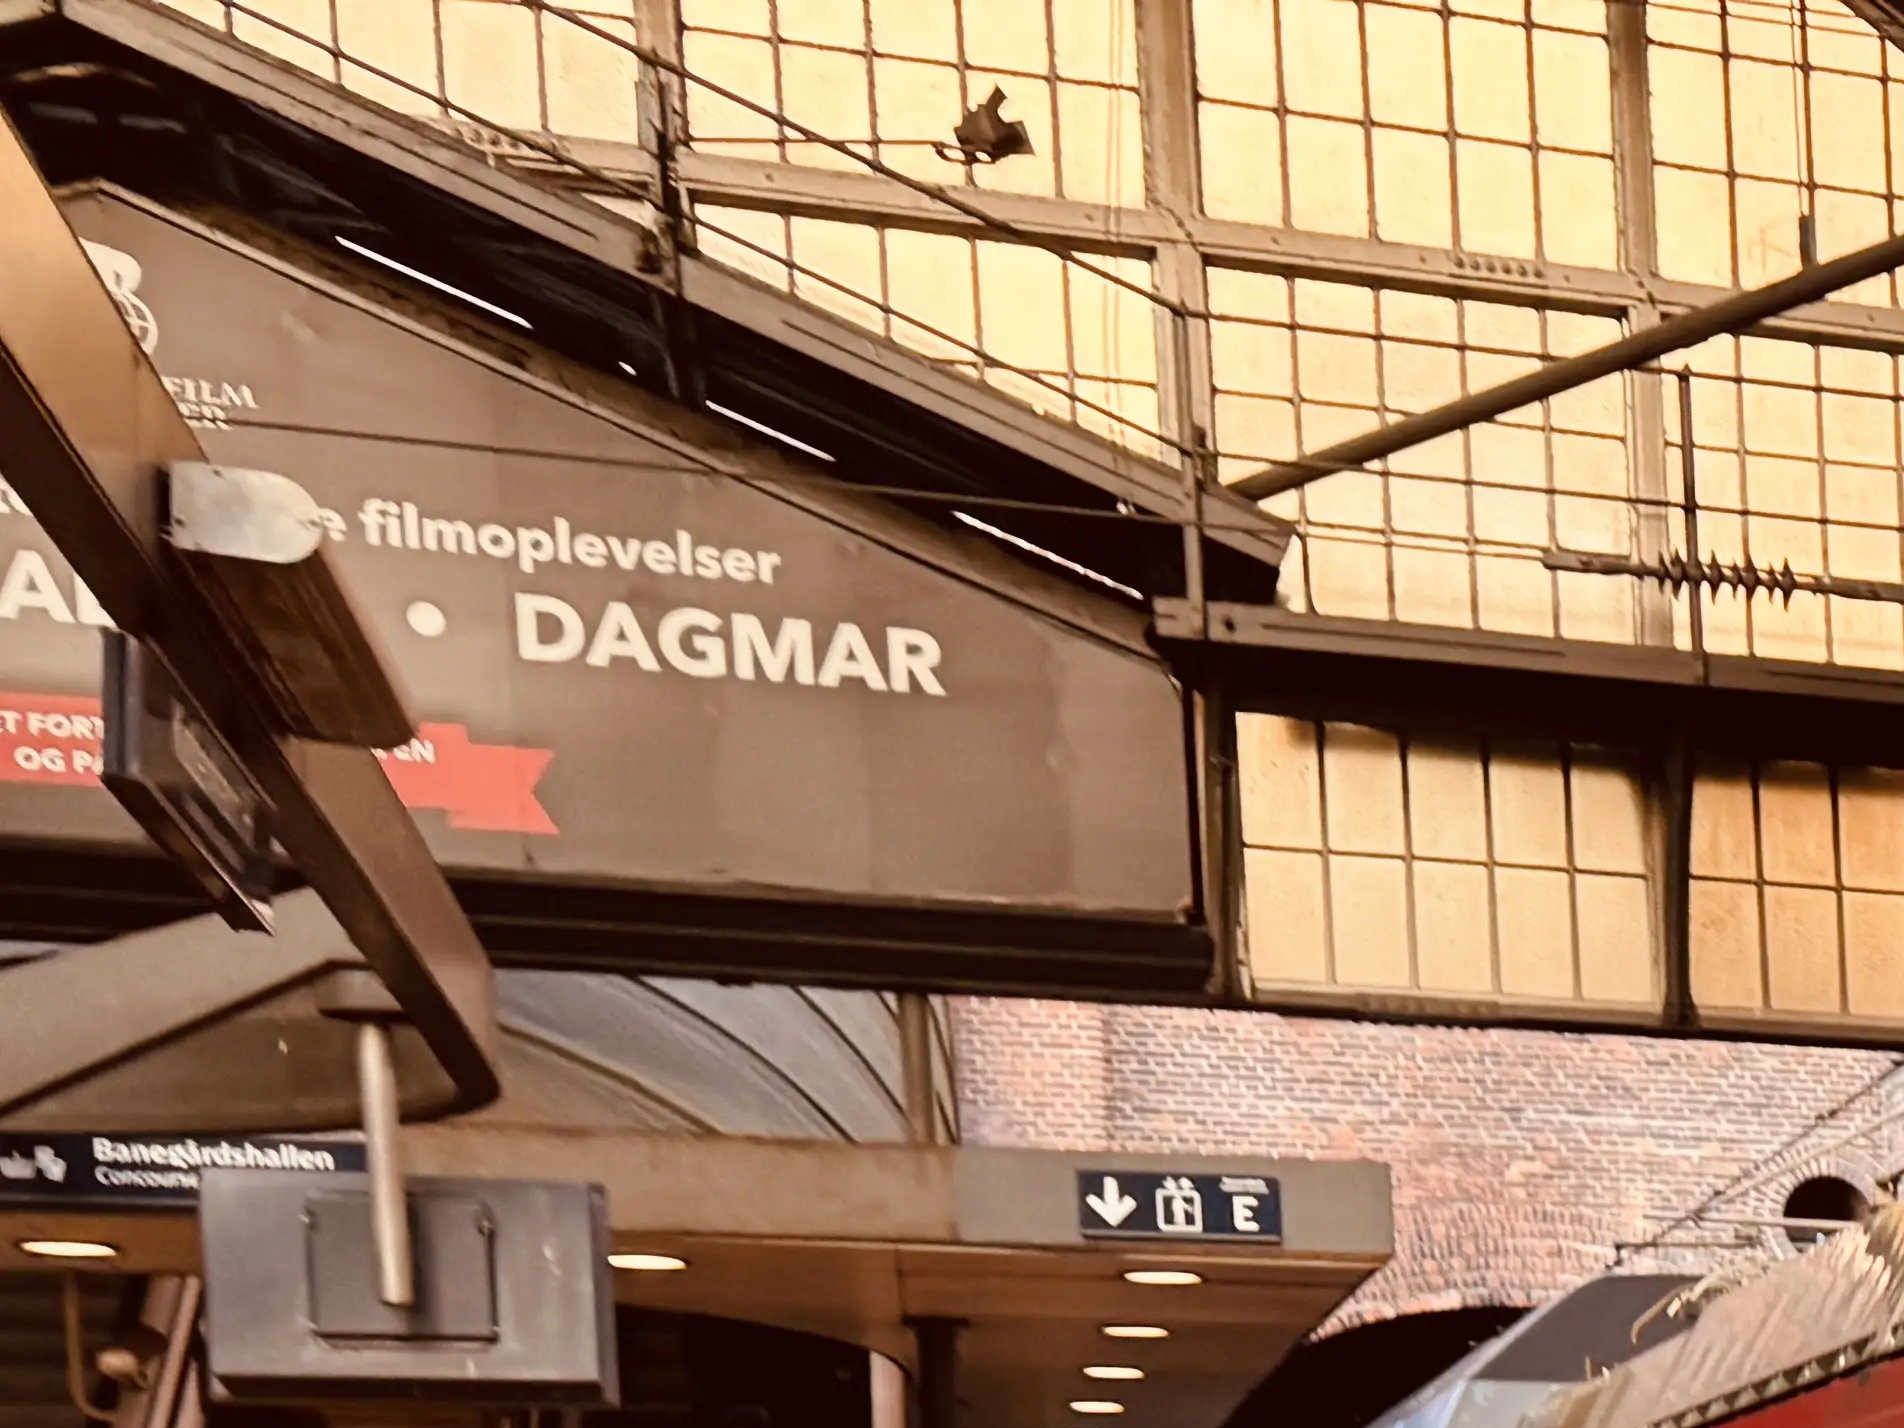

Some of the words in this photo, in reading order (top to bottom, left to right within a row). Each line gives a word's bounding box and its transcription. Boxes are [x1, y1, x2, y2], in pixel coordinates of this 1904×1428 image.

[358, 498, 782, 585] filmoplevelser
[514, 592, 947, 696] DAGMAR
[14, 745, 66, 773] OG
[1232, 1195, 1260, 1232] E
